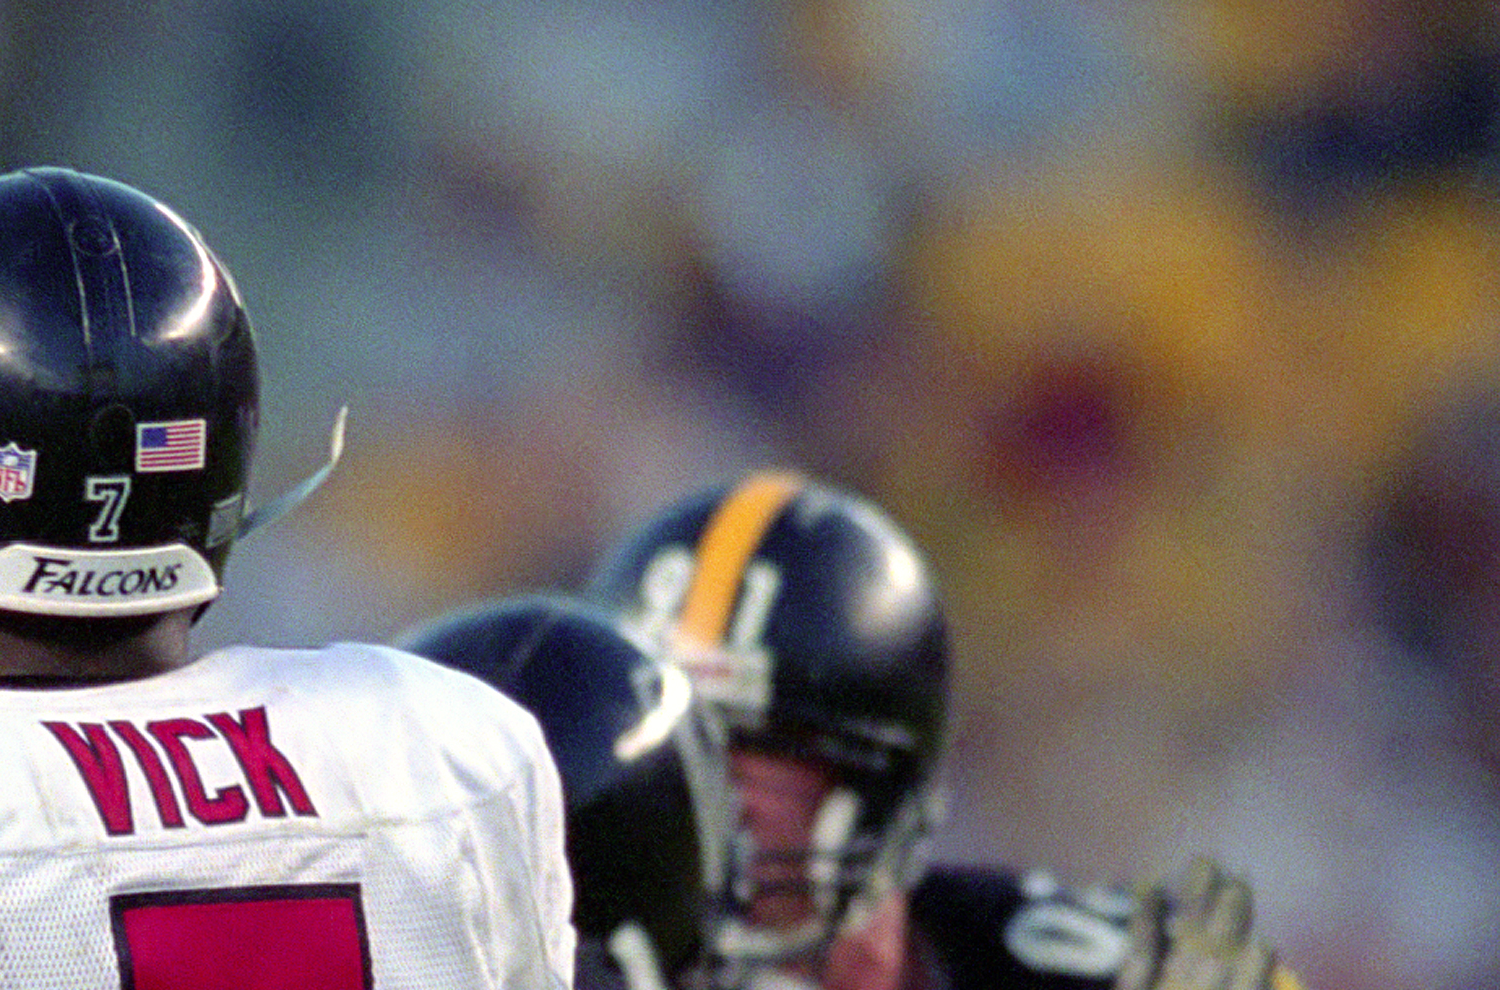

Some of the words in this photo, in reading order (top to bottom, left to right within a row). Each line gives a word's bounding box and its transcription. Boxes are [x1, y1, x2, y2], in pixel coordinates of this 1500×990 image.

[85, 476, 132, 541] 7
[22, 556, 183, 596] FALCONS
[40, 706, 319, 835] VICK
